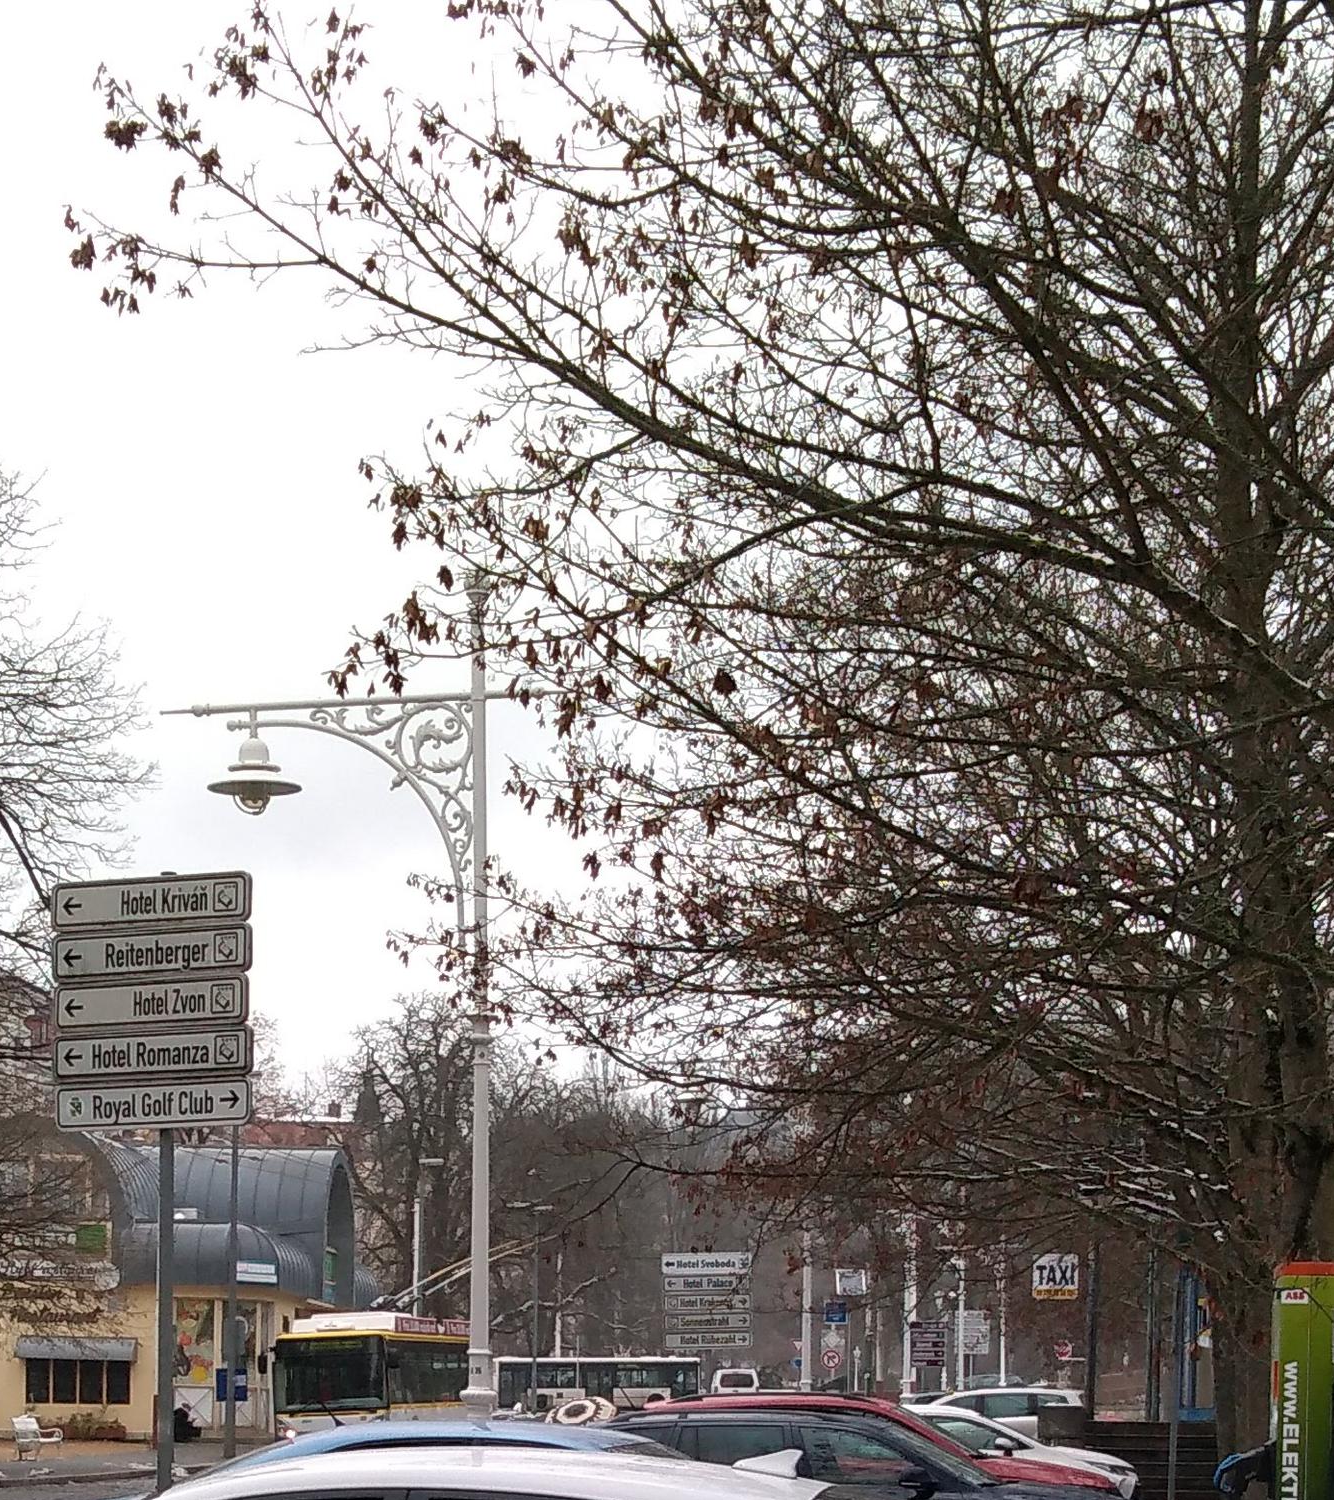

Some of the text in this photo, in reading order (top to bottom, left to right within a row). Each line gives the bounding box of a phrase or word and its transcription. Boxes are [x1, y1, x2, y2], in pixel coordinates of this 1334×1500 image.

[120, 885, 208, 916] Hotel Kriváň
[105, 940, 209, 971] Reitenberger
[133, 988, 206, 1017] Hotel Zvon
[92, 1040, 209, 1069] Hotel Romanza
[92, 1089, 214, 1124] Royal Golf Club
[676, 1258, 736, 1269] Hotel Svoboda
[1036, 1262, 1075, 1285] TAXI
[683, 1278, 733, 1289] Hotel Palace
[679, 1298, 698, 1307] Hotel
[1285, 1292, 1305, 1300] ABB
[680, 1335, 700, 1345] Hotel
